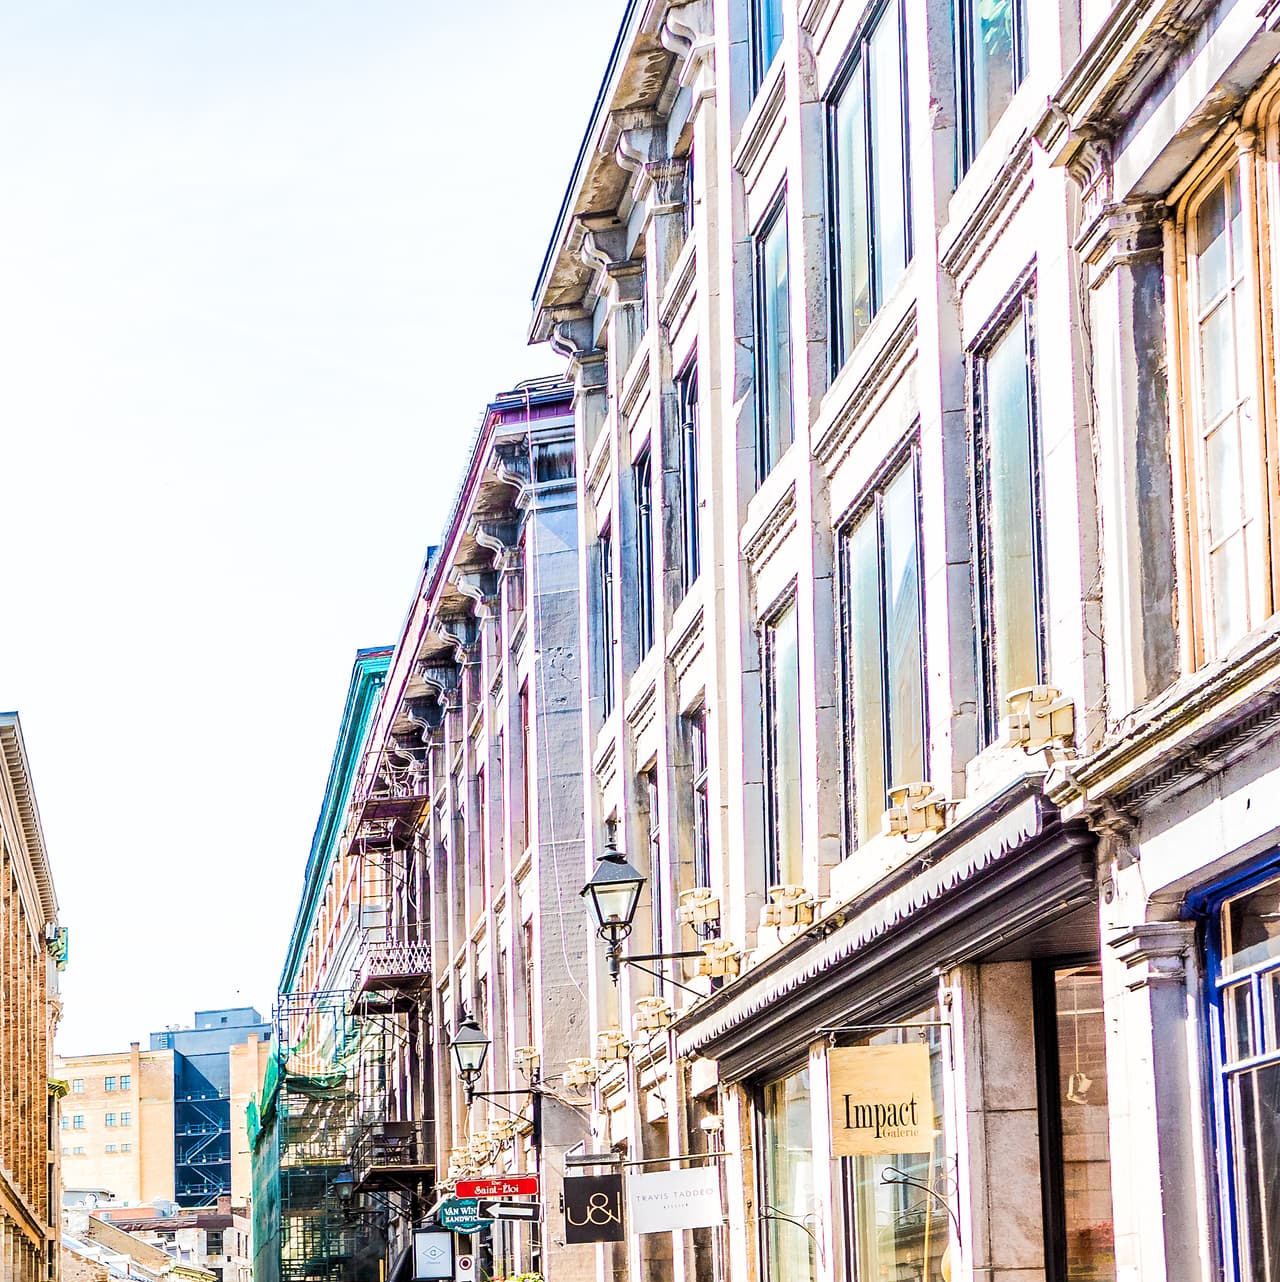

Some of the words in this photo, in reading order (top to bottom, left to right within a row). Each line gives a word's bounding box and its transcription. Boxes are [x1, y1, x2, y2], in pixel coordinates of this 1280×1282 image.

[842, 1091, 918, 1139] Impact
[882, 1127, 919, 1138] Galerie
[474, 1183, 520, 1195] Saint-Éloi
[636, 1192, 669, 1201] TRAVIS
[673, 1188, 714, 1198] TADDEO
[444, 1207, 459, 1216] VAN
